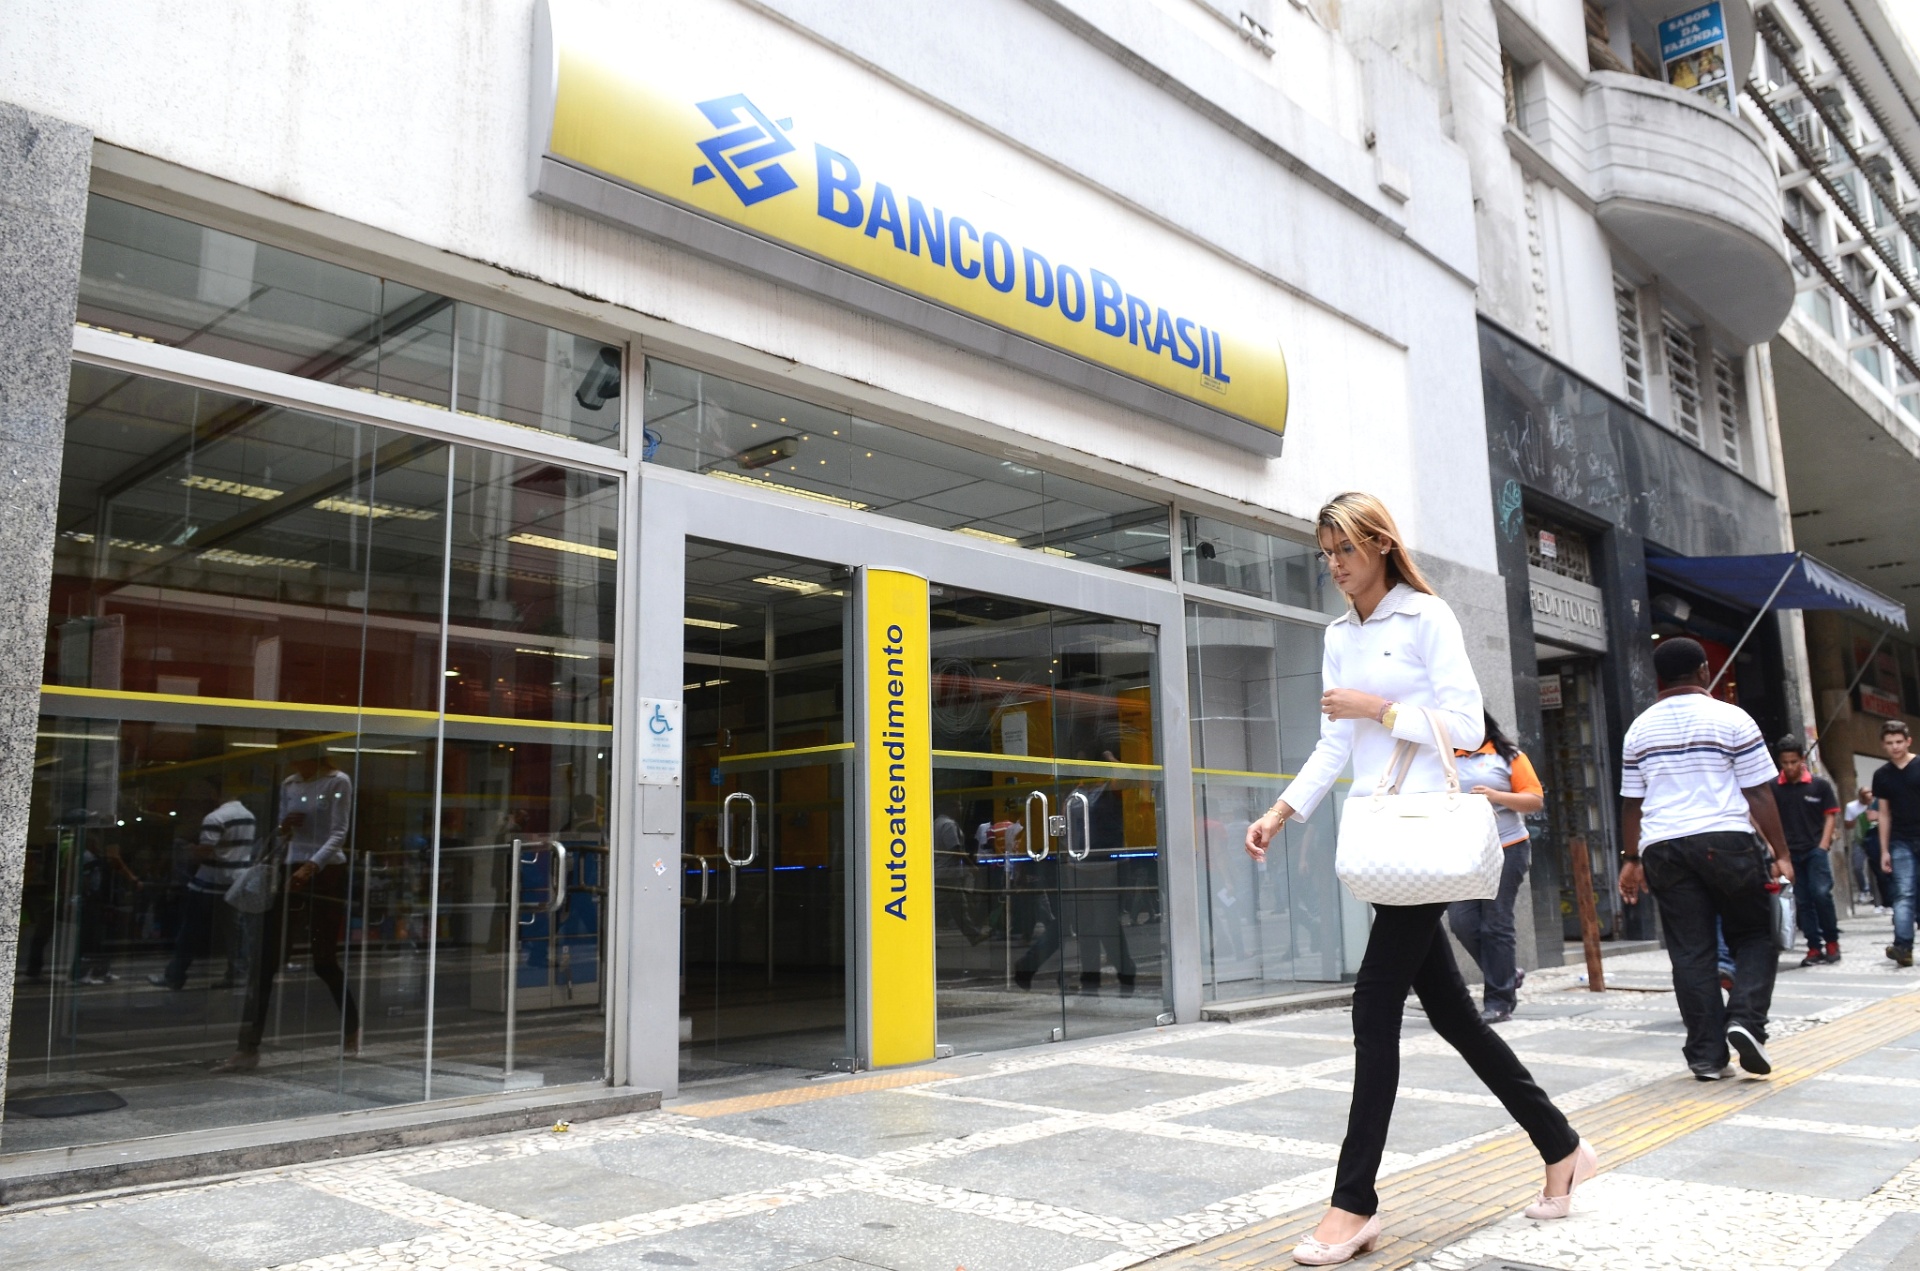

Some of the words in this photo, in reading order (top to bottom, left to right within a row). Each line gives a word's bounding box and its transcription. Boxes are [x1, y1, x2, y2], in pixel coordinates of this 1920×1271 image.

[1668, 9, 1710, 31] SABOR
[1681, 23, 1700, 37] DA
[1664, 26, 1722, 54] FAZENDA
[813, 142, 1016, 294] BANCO
[1022, 246, 1086, 323] DO
[1089, 267, 1231, 384] BRASIL
[1530, 588, 1561, 617] REDIO
[882, 624, 907, 921] Autoatendimento
